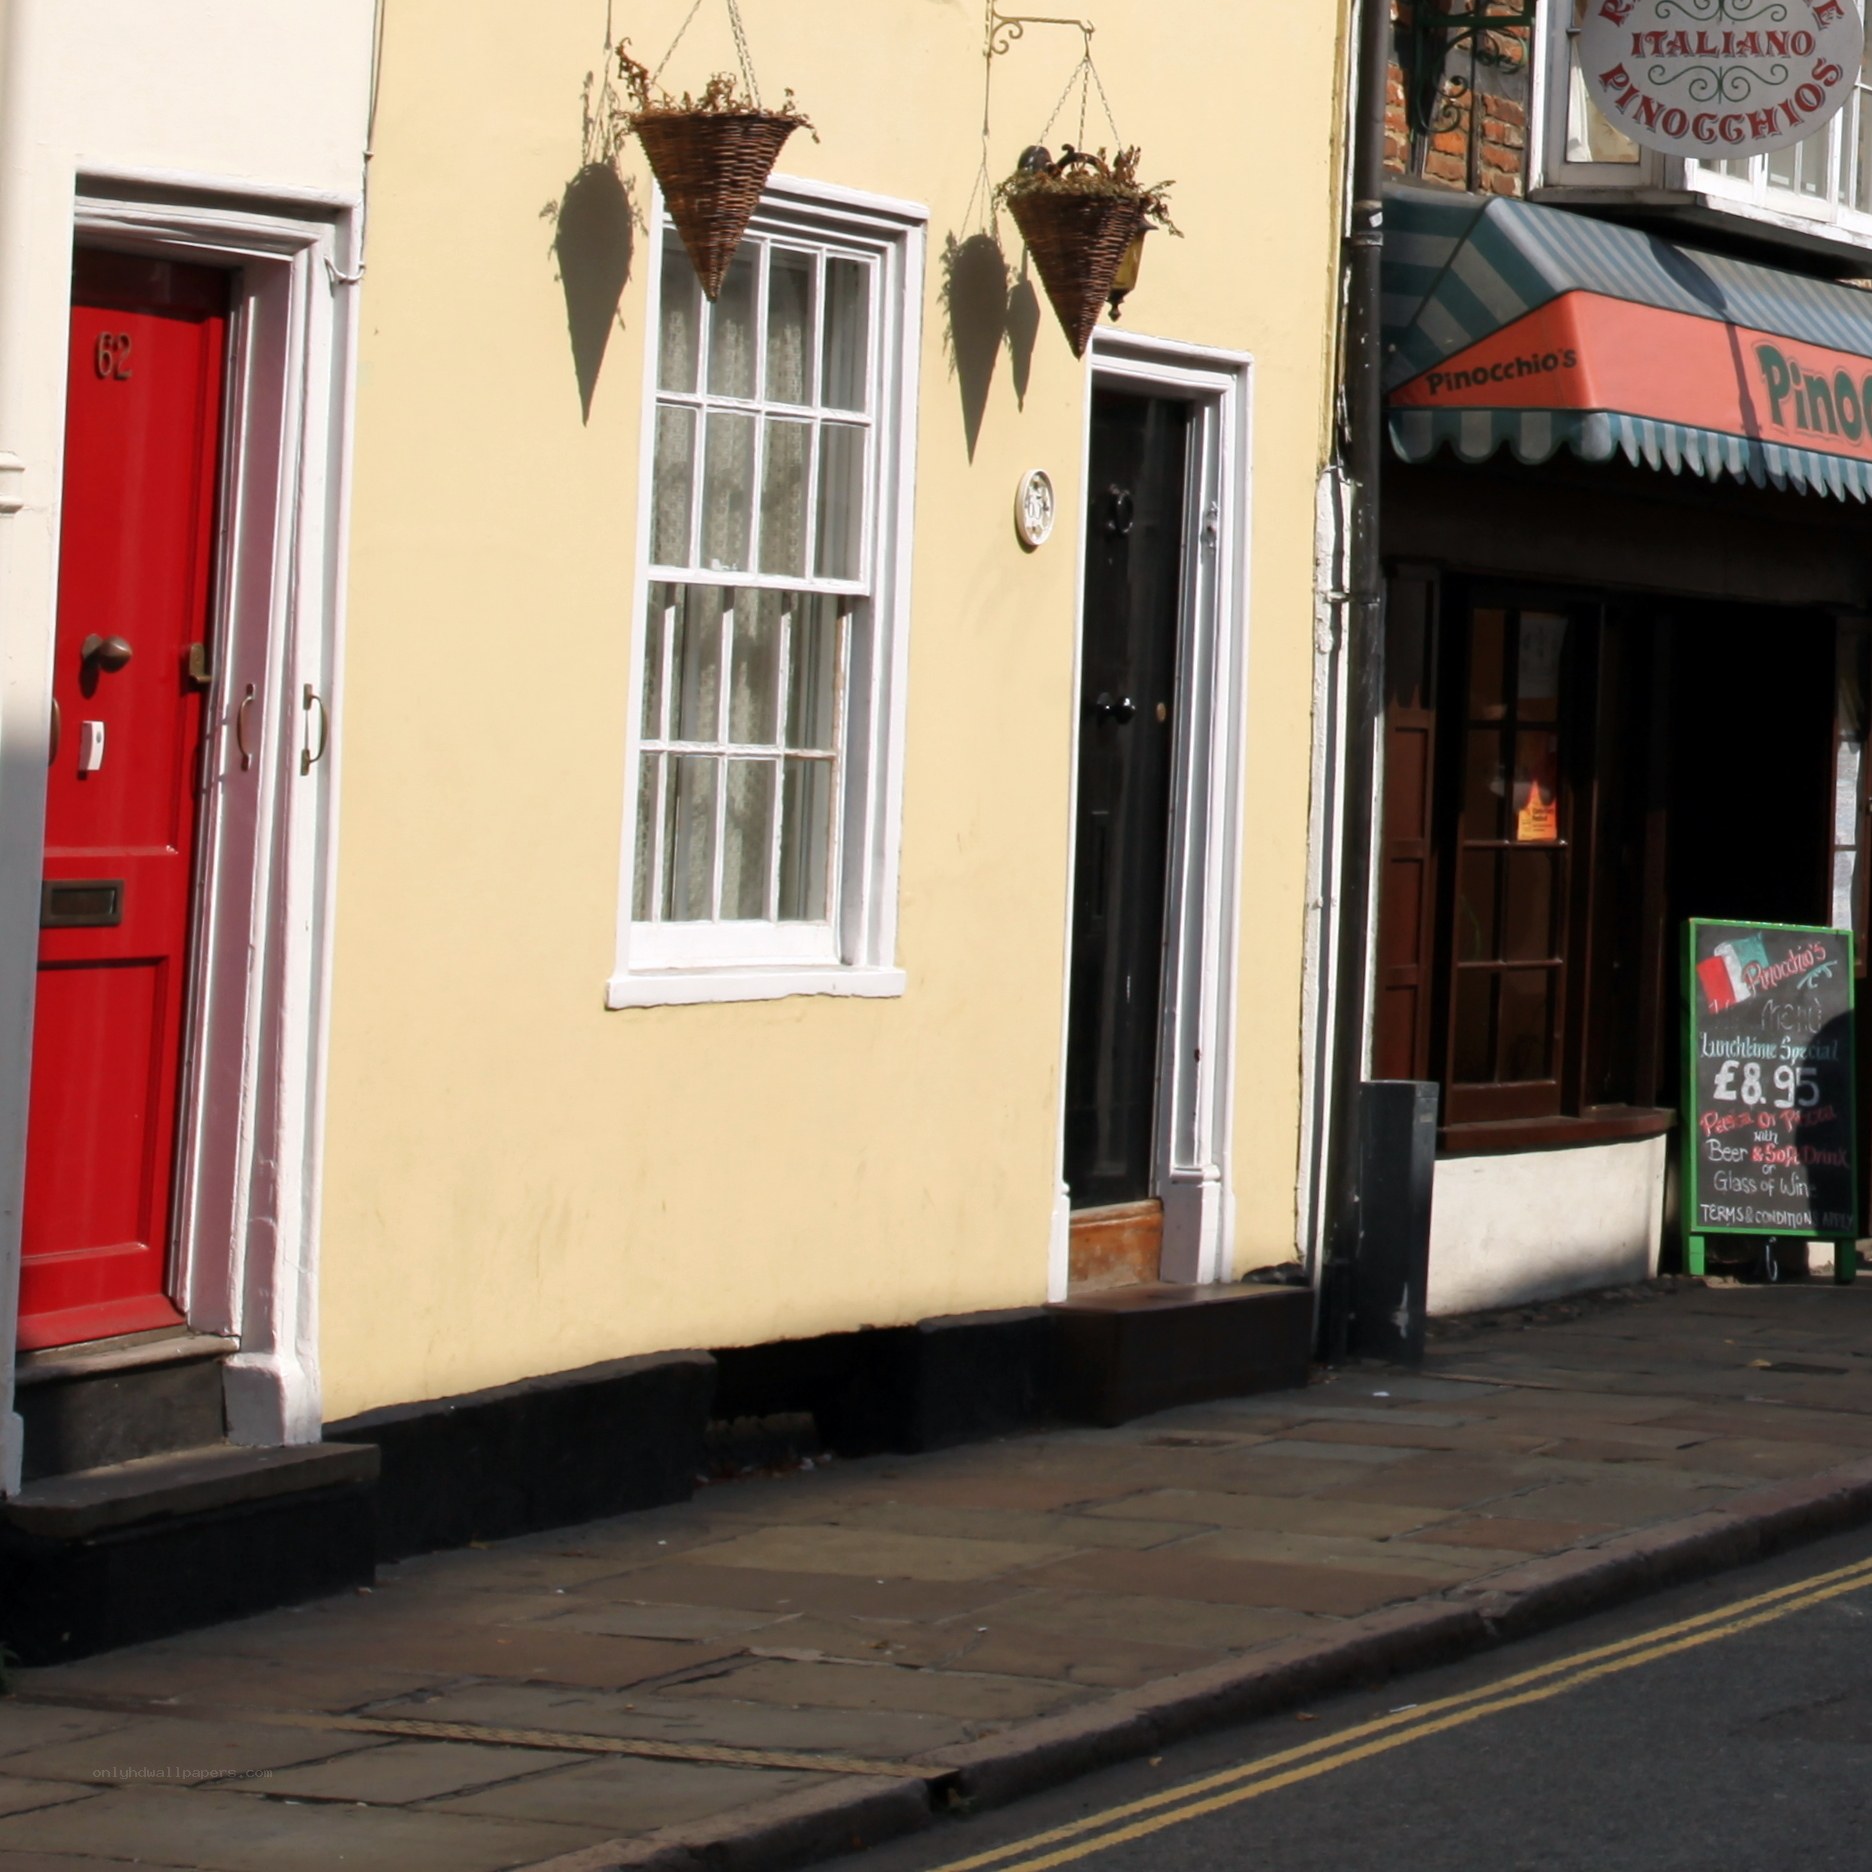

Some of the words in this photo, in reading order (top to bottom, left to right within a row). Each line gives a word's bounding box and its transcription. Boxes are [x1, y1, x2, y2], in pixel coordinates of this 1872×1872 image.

[1630, 30, 1816, 59] ITALIANO
[1599, 56, 1845, 147] PINOCCHIOS
[96, 330, 133, 379] 62
[1425, 345, 1577, 396] Pinocchio's
[1741, 943, 1826, 996] Pinocchio's
[1700, 1031, 1777, 1059] Lunchtime
[1779, 1034, 1839, 1066] Special
[1713, 1058, 1821, 1109] £8.95
[1705, 1138, 1749, 1163] Beer
[1764, 1142, 1801, 1167] Soft
[1803, 1143, 1850, 1168] Drink
[1761, 1163, 1777, 1175] or
[1713, 1170, 1758, 1194] Glass
[1759, 1178, 1776, 1197] of
[1780, 1171, 1817, 1198] Wine
[1699, 1203, 1745, 1225] TERMS
